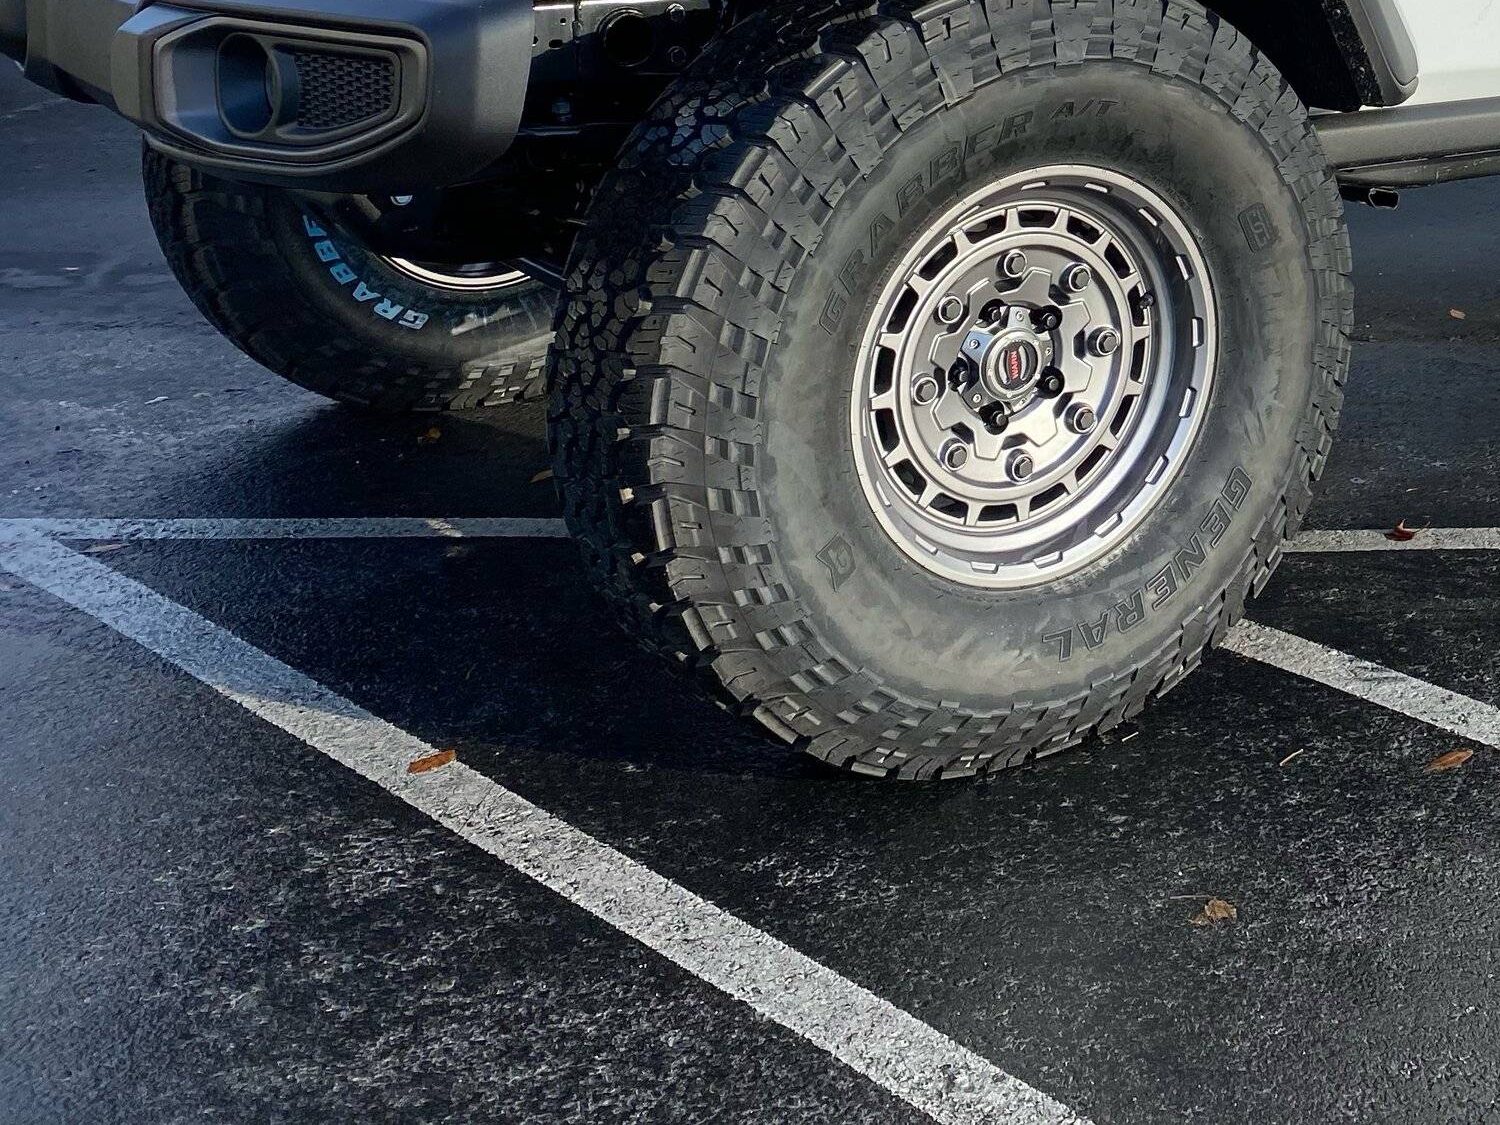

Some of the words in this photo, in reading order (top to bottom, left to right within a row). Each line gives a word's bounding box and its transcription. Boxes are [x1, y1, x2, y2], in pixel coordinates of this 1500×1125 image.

[302, 214, 430, 330] GRABBE
[819, 110, 1035, 336] GRABBER
[1010, 350, 1020, 380] WARN
[1042, 466, 1253, 662] GENERAL
